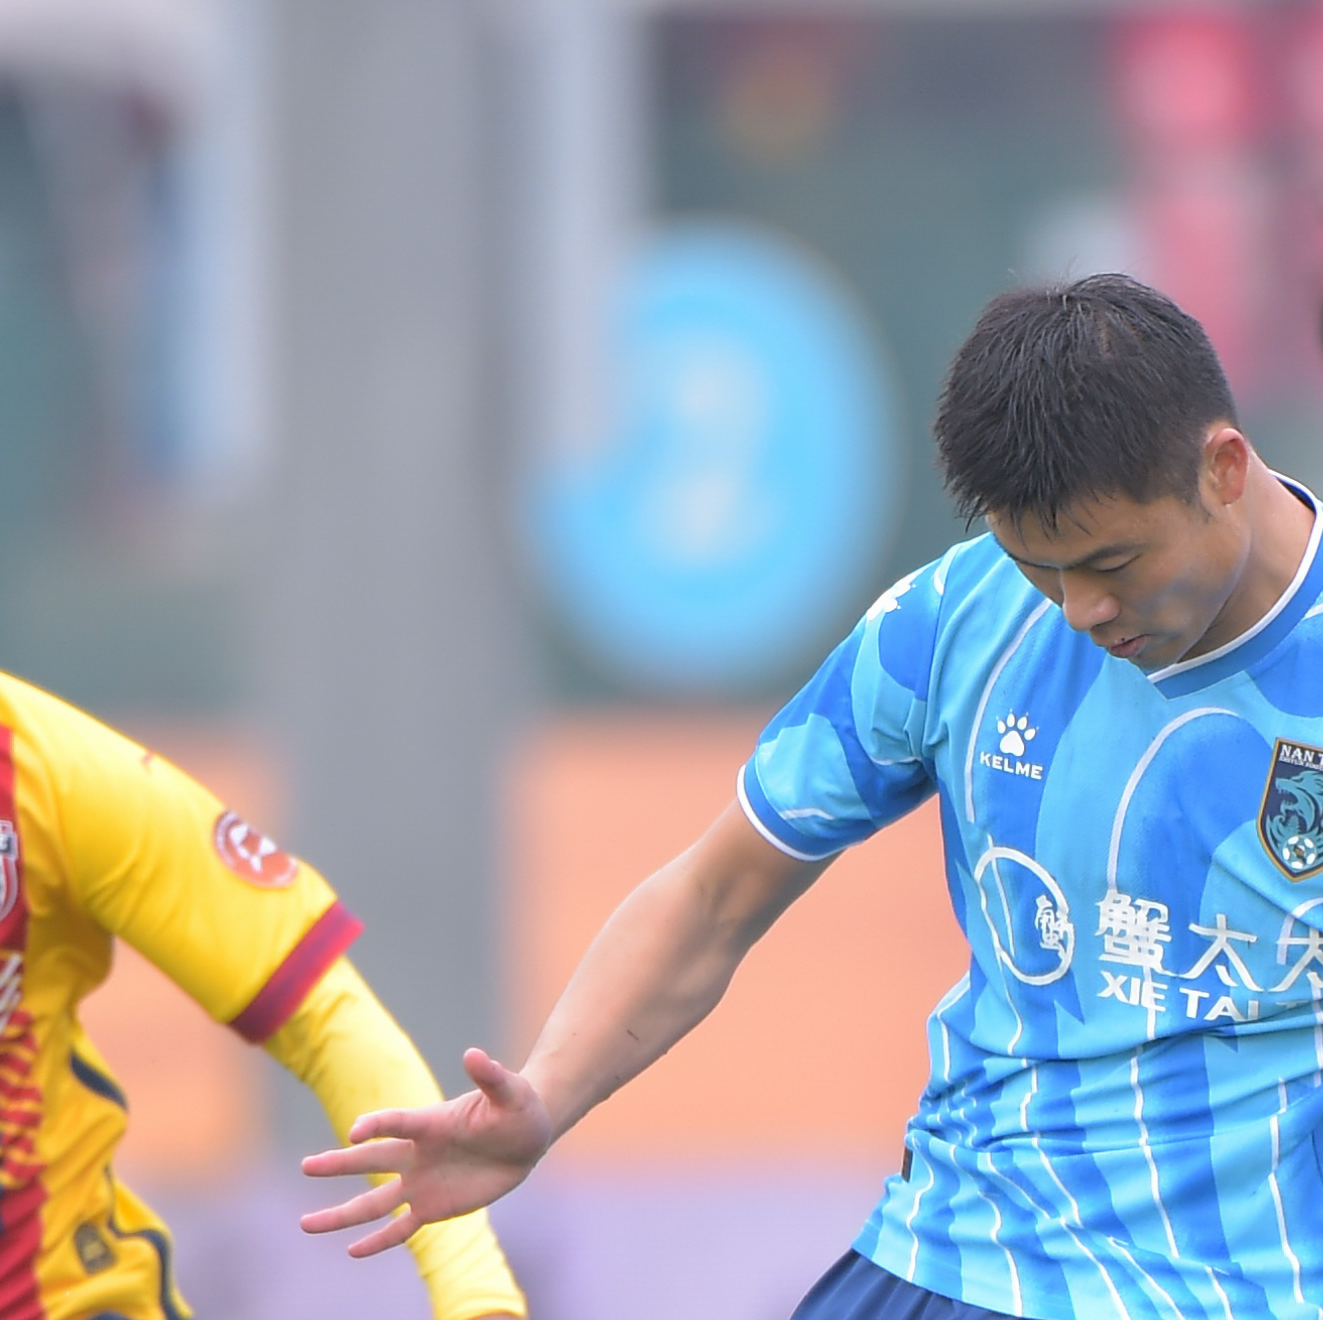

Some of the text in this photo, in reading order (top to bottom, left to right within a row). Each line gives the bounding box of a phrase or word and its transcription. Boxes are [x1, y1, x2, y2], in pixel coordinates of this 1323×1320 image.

[980, 751, 1043, 780] KELME
[1280, 744, 1314, 763] NAN
[1097, 970, 1260, 1022] XIE TAI
